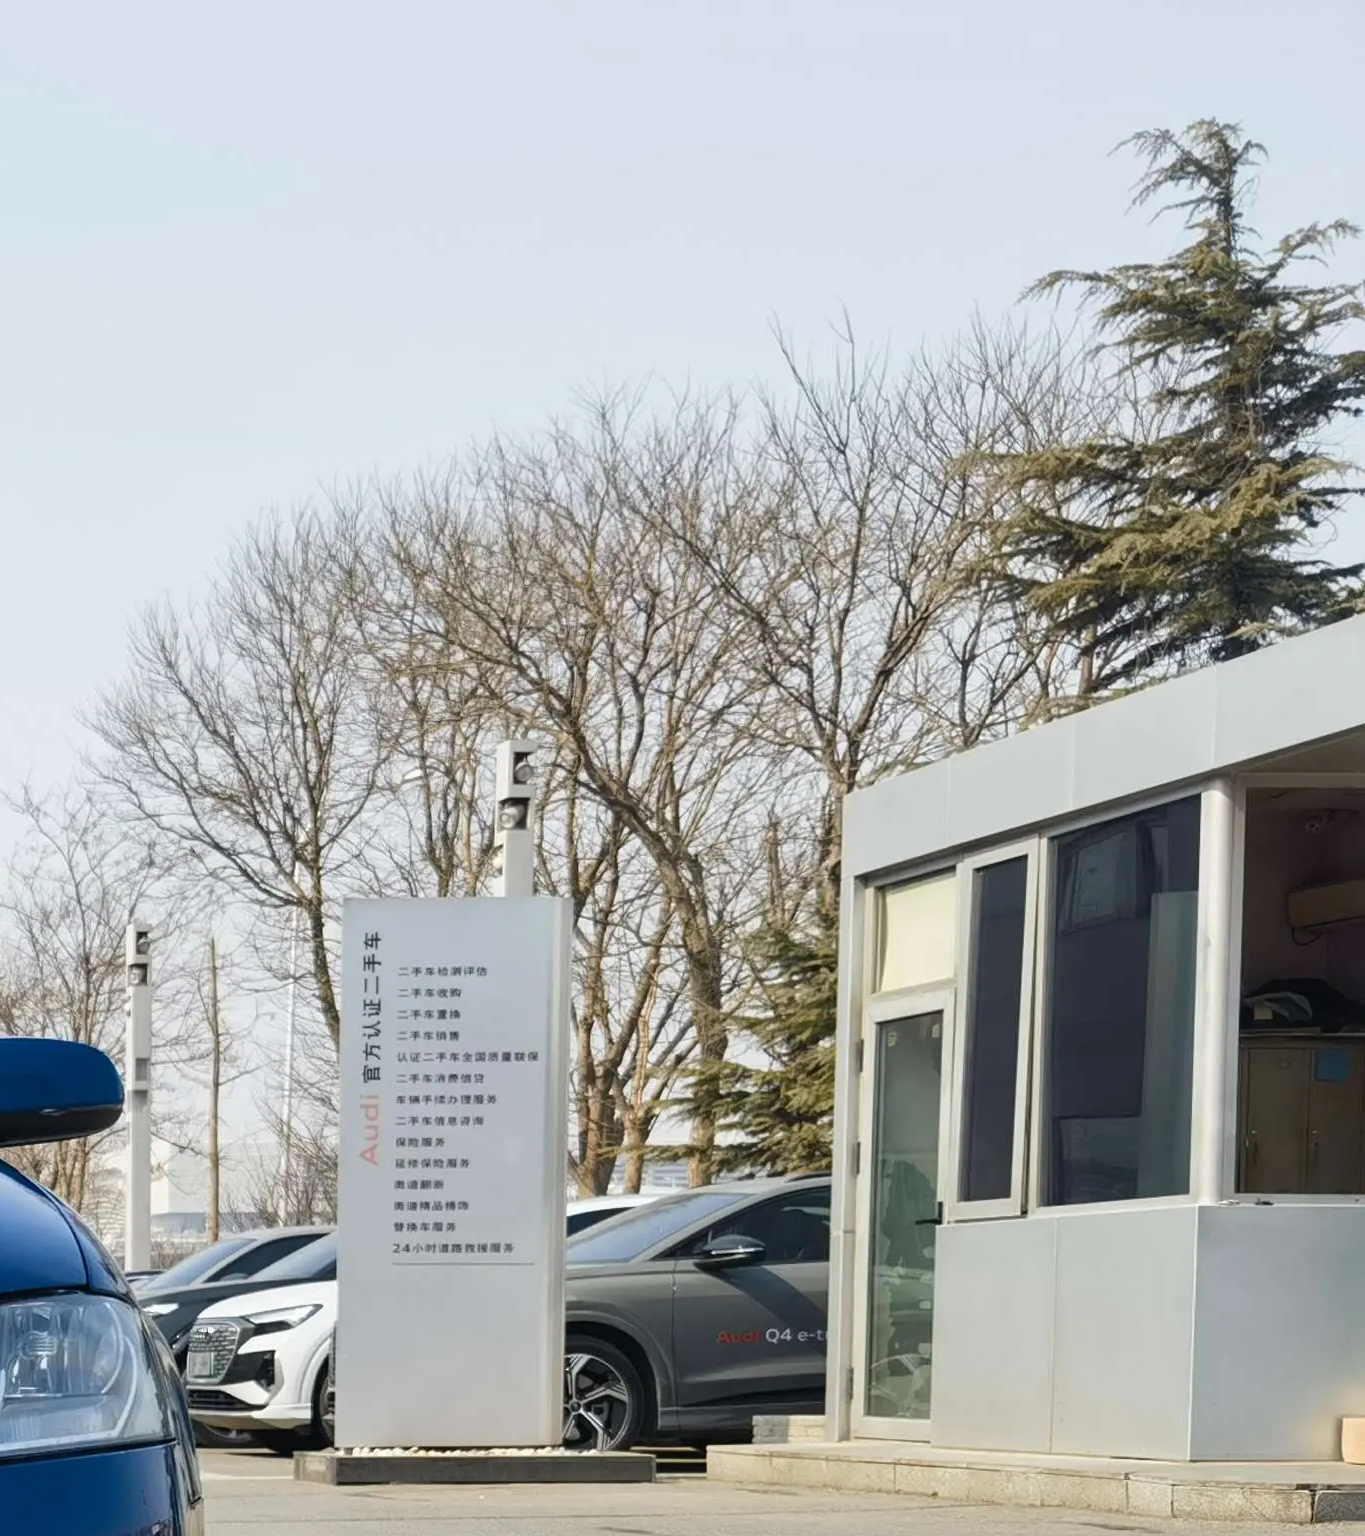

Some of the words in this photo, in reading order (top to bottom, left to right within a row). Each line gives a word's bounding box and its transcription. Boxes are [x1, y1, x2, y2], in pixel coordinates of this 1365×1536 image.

[397, 966, 488, 977] 二手车检测评估
[396, 988, 462, 998] 二手车收购
[362, 931, 382, 1084] 官方认证二手车
[396, 1009, 461, 1020] 二手车置换
[396, 1031, 460, 1041] 二手车销售
[397, 1052, 539, 1063] 认证二手车全国质量联保
[395, 1073, 485, 1084] 二手车消费信贷
[396, 1094, 497, 1105] 车辆手续办理服务
[395, 1116, 484, 1127] 二手车信息咨询
[359, 1093, 380, 1166] Audi
[395, 1137, 445, 1148] 保险服务
[393, 1221, 456, 1232] 替换车服务
[392, 1242, 514, 1254] 24小时道路救援服务
[717, 1330, 762, 1343] Audi
[765, 1328, 792, 1344] Q4
